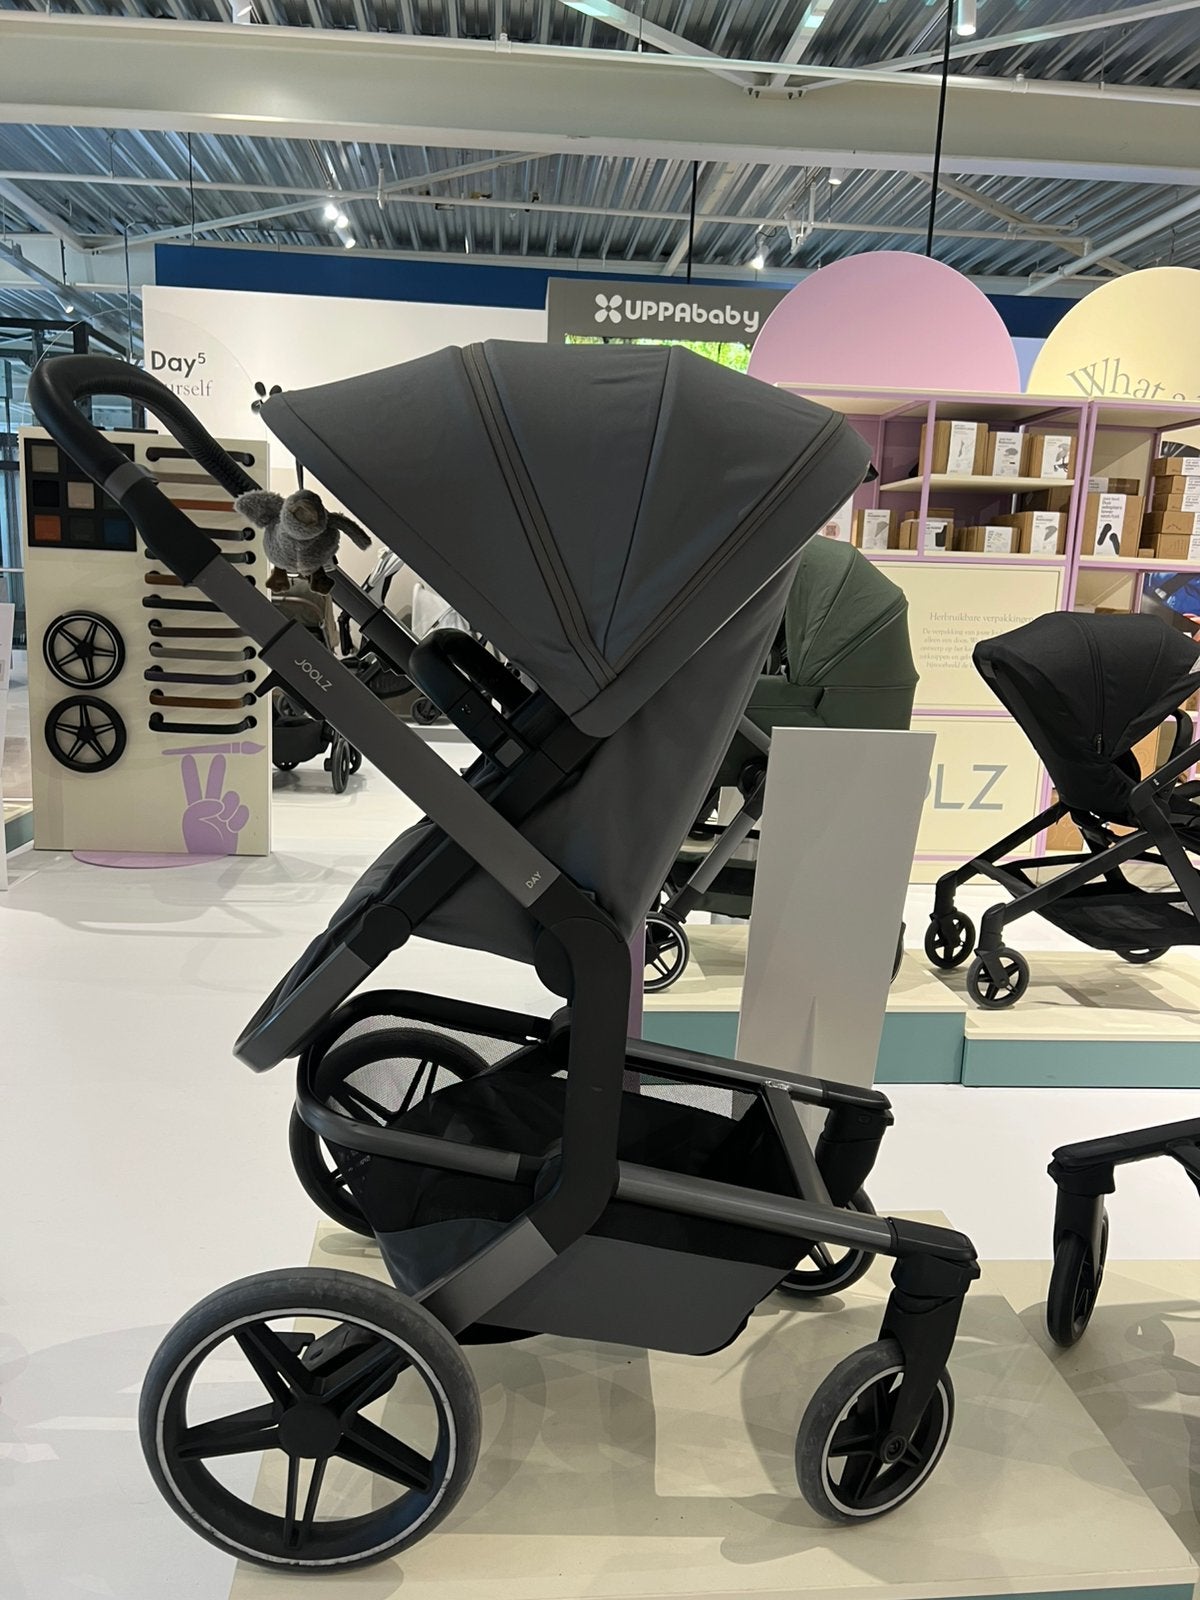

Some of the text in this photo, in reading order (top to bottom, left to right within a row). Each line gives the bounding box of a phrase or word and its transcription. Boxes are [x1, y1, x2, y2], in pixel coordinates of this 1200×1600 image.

[625, 300, 759, 333] UPPAbaby
[294, 659, 332, 692] JOOLZ
[924, 763, 1008, 810] LZ
[525, 871, 541, 888] DAY
